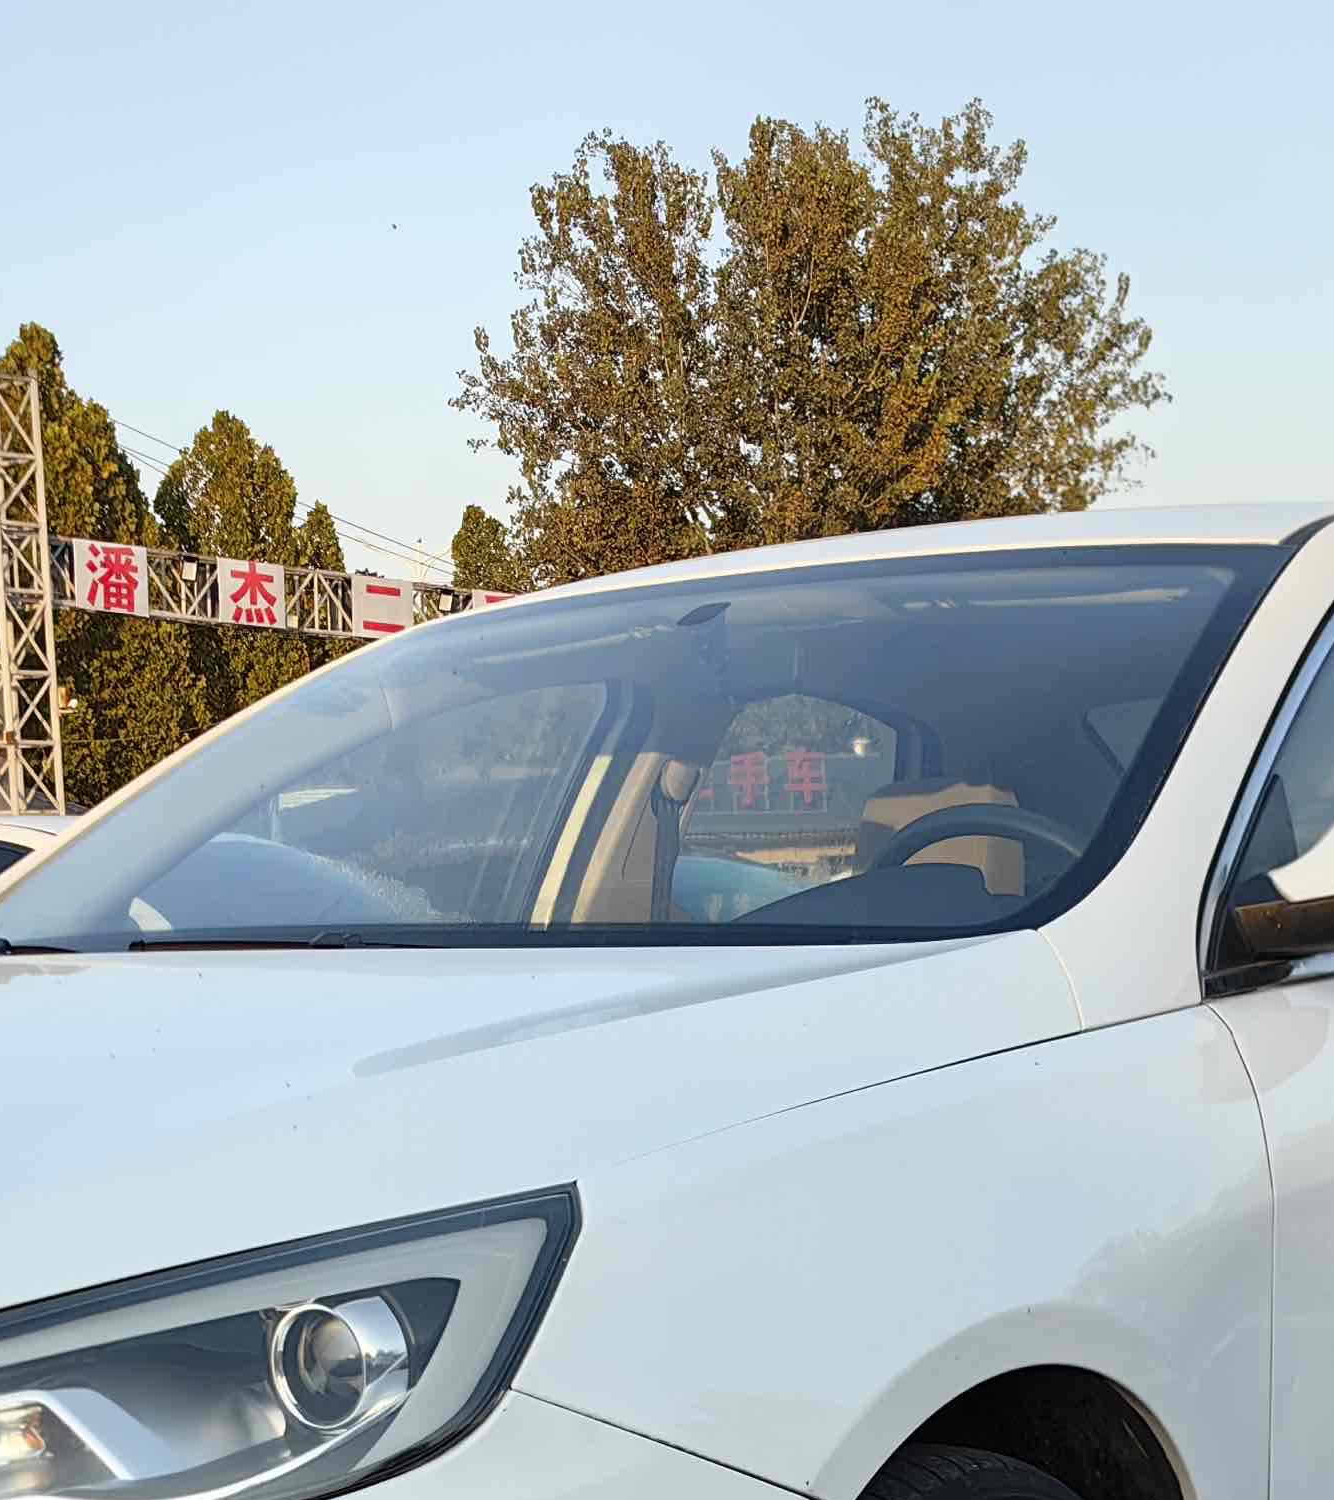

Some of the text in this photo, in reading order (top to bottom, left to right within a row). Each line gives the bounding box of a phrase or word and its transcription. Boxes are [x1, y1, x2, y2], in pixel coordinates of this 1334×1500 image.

[85, 543, 517, 634] 潘杰二
[697, 748, 828, 807] 手车
